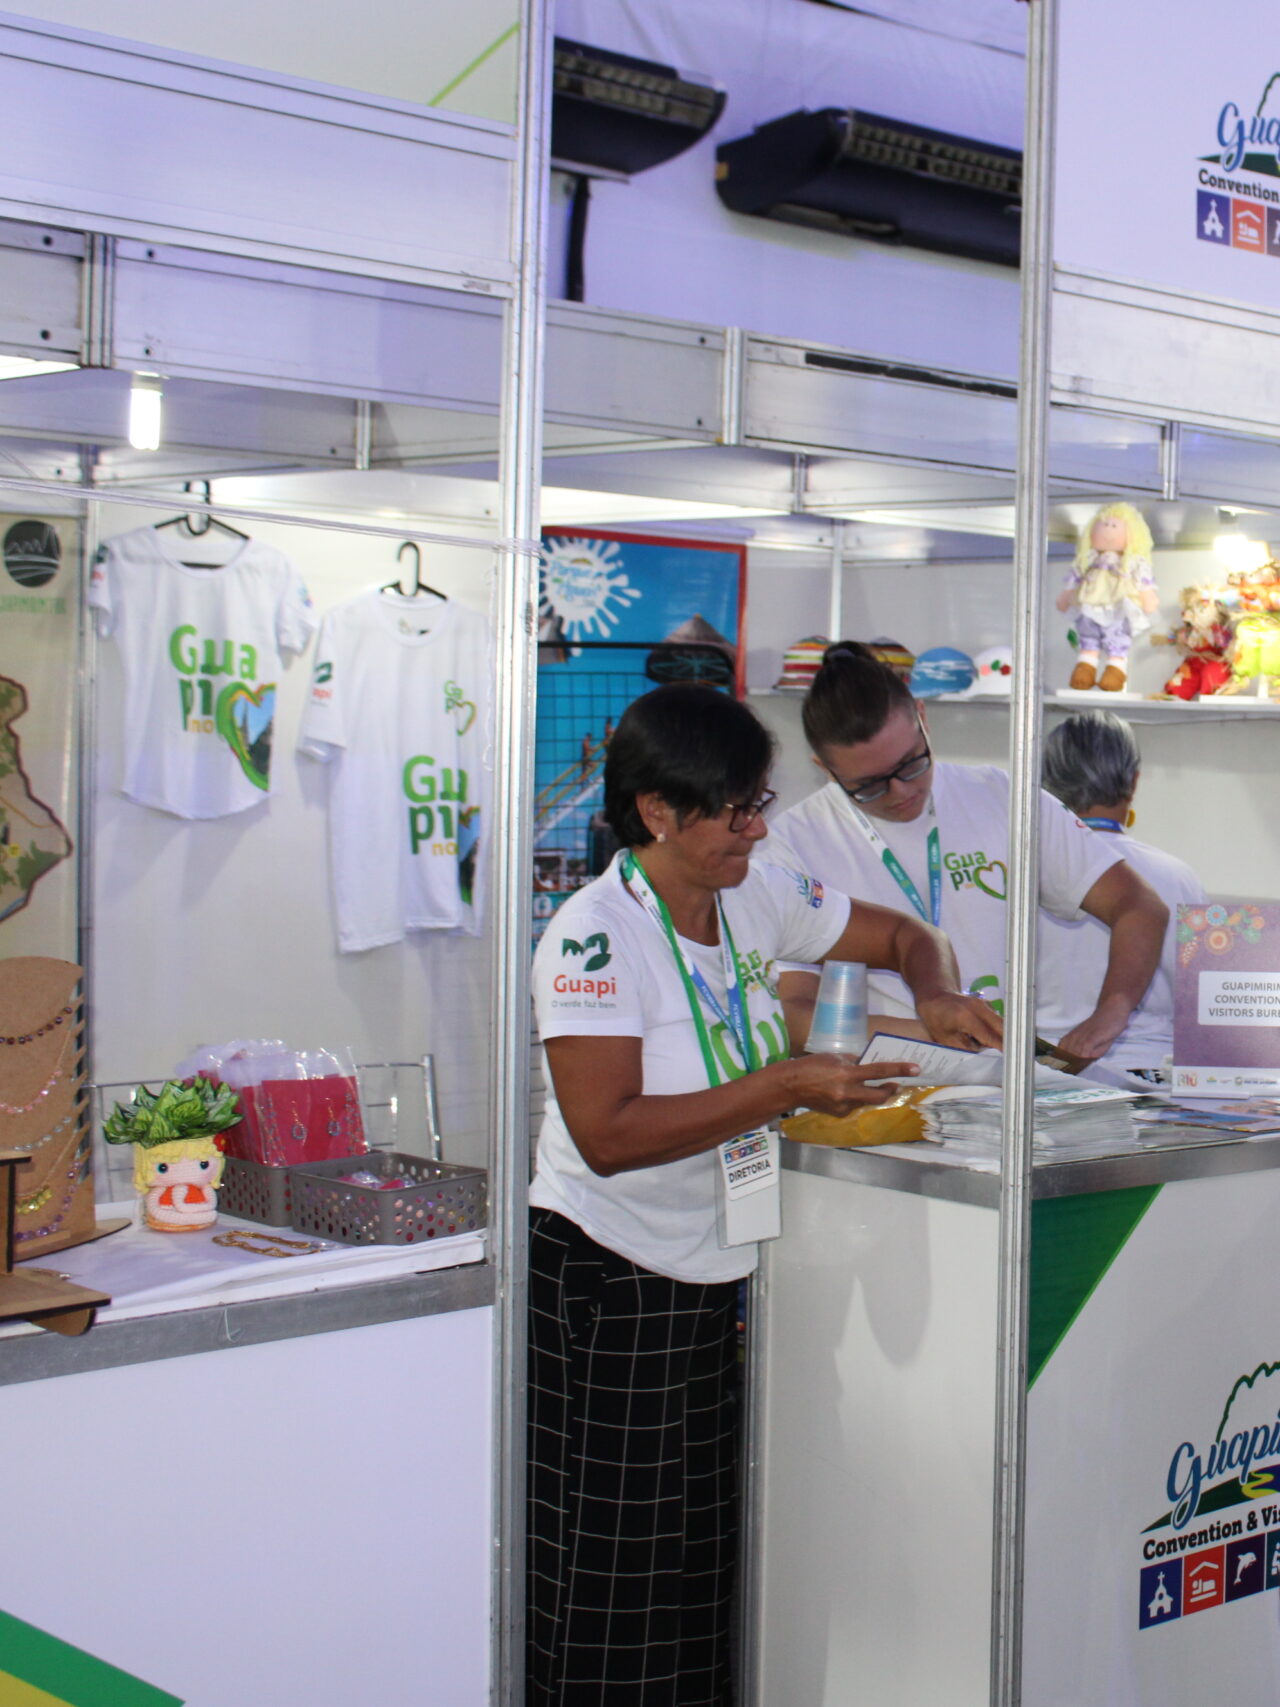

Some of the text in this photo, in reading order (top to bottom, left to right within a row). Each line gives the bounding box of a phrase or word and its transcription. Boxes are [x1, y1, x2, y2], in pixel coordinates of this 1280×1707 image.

[1199, 169, 1279, 203] Convention
[169, 625, 256, 681] Gua
[944, 852, 987, 871] Gua
[951, 869, 972, 891] pi
[554, 975, 617, 998] Guapi
[1209, 1007, 1254, 1018] VISITORS
[728, 1159, 771, 1183] DIRETORIA
[1143, 1516, 1242, 1561] Convention
[1247, 1509, 1258, 1529] &
